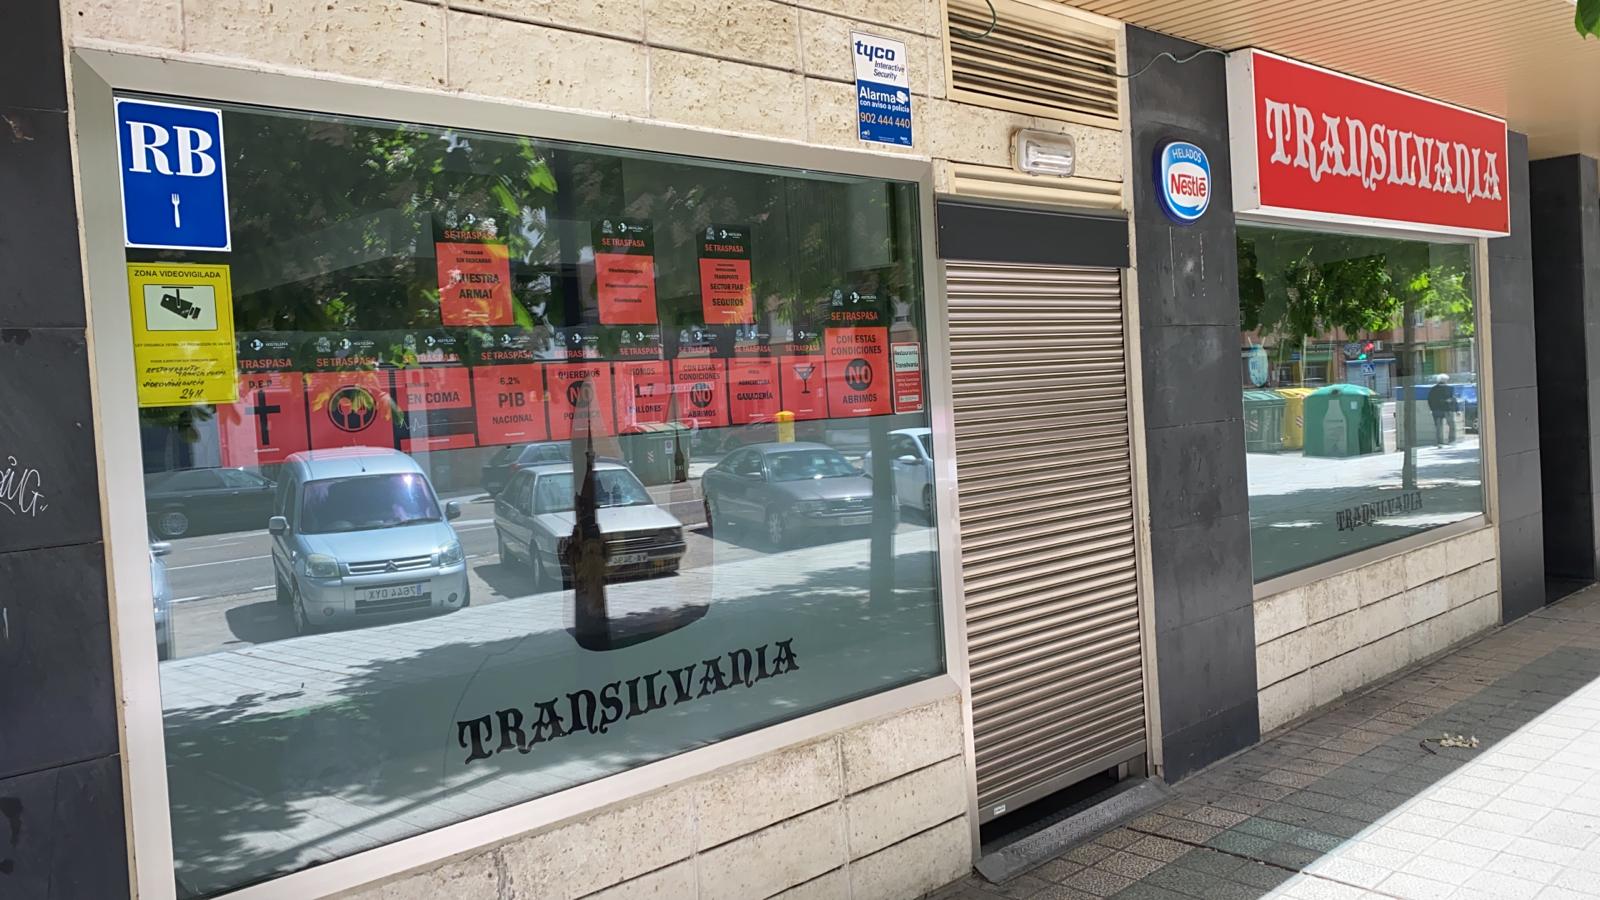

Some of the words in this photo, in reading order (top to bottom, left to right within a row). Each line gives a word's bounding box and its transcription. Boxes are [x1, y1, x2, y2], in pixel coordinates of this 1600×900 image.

[855, 40, 895, 62] tyco
[874, 60, 905, 73] Interactive
[873, 68, 897, 81] Security
[860, 86, 896, 104] Alarma
[871, 101, 887, 110] aviso
[860, 112, 876, 124] 902
[877, 115, 893, 126] 444
[895, 118, 911, 129] 440
[126, 121, 216, 177] RB
[1264, 97, 1502, 204] TRANSILVANIA
[1172, 148, 1202, 163] HELADOS
[601, 238, 611, 246] SE
[611, 238, 645, 247] TRASPASA
[704, 243, 714, 251] SE
[714, 244, 744, 252] TRASPASA
[134, 270, 158, 278] ZONA
[160, 270, 221, 279] VIDEOVIGILADA
[712, 298, 744, 306] SEGUROS
[831, 311, 841, 320] SE
[842, 311, 880, 321] TRASPASA
[836, 335, 852, 344] CON
[855, 334, 876, 344] ESTAS
[481, 352, 492, 360] SE
[493, 351, 533, 360] TRASPASA
[831, 345, 882, 355] CONDICIONES
[240, 359, 293, 369] TRASPASA
[316, 357, 328, 367] SE
[558, 369, 601, 380] QUEREMOS
[679, 373, 720, 381] CONDICIONES
[848, 365, 871, 385] NO
[407, 392, 422, 405] EN
[425, 391, 461, 404] COMA
[569, 386, 594, 402] NO
[692, 386, 712, 403] NO
[842, 394, 878, 404] ABRIMOS
[498, 392, 526, 409] PIB
[688, 409, 716, 418] ABRIMOS
[492, 414, 534, 425] NACIONAL
[1336, 491, 1424, 531] TRANSILVANIA
[457, 637, 800, 765] TRANSILVANIA
